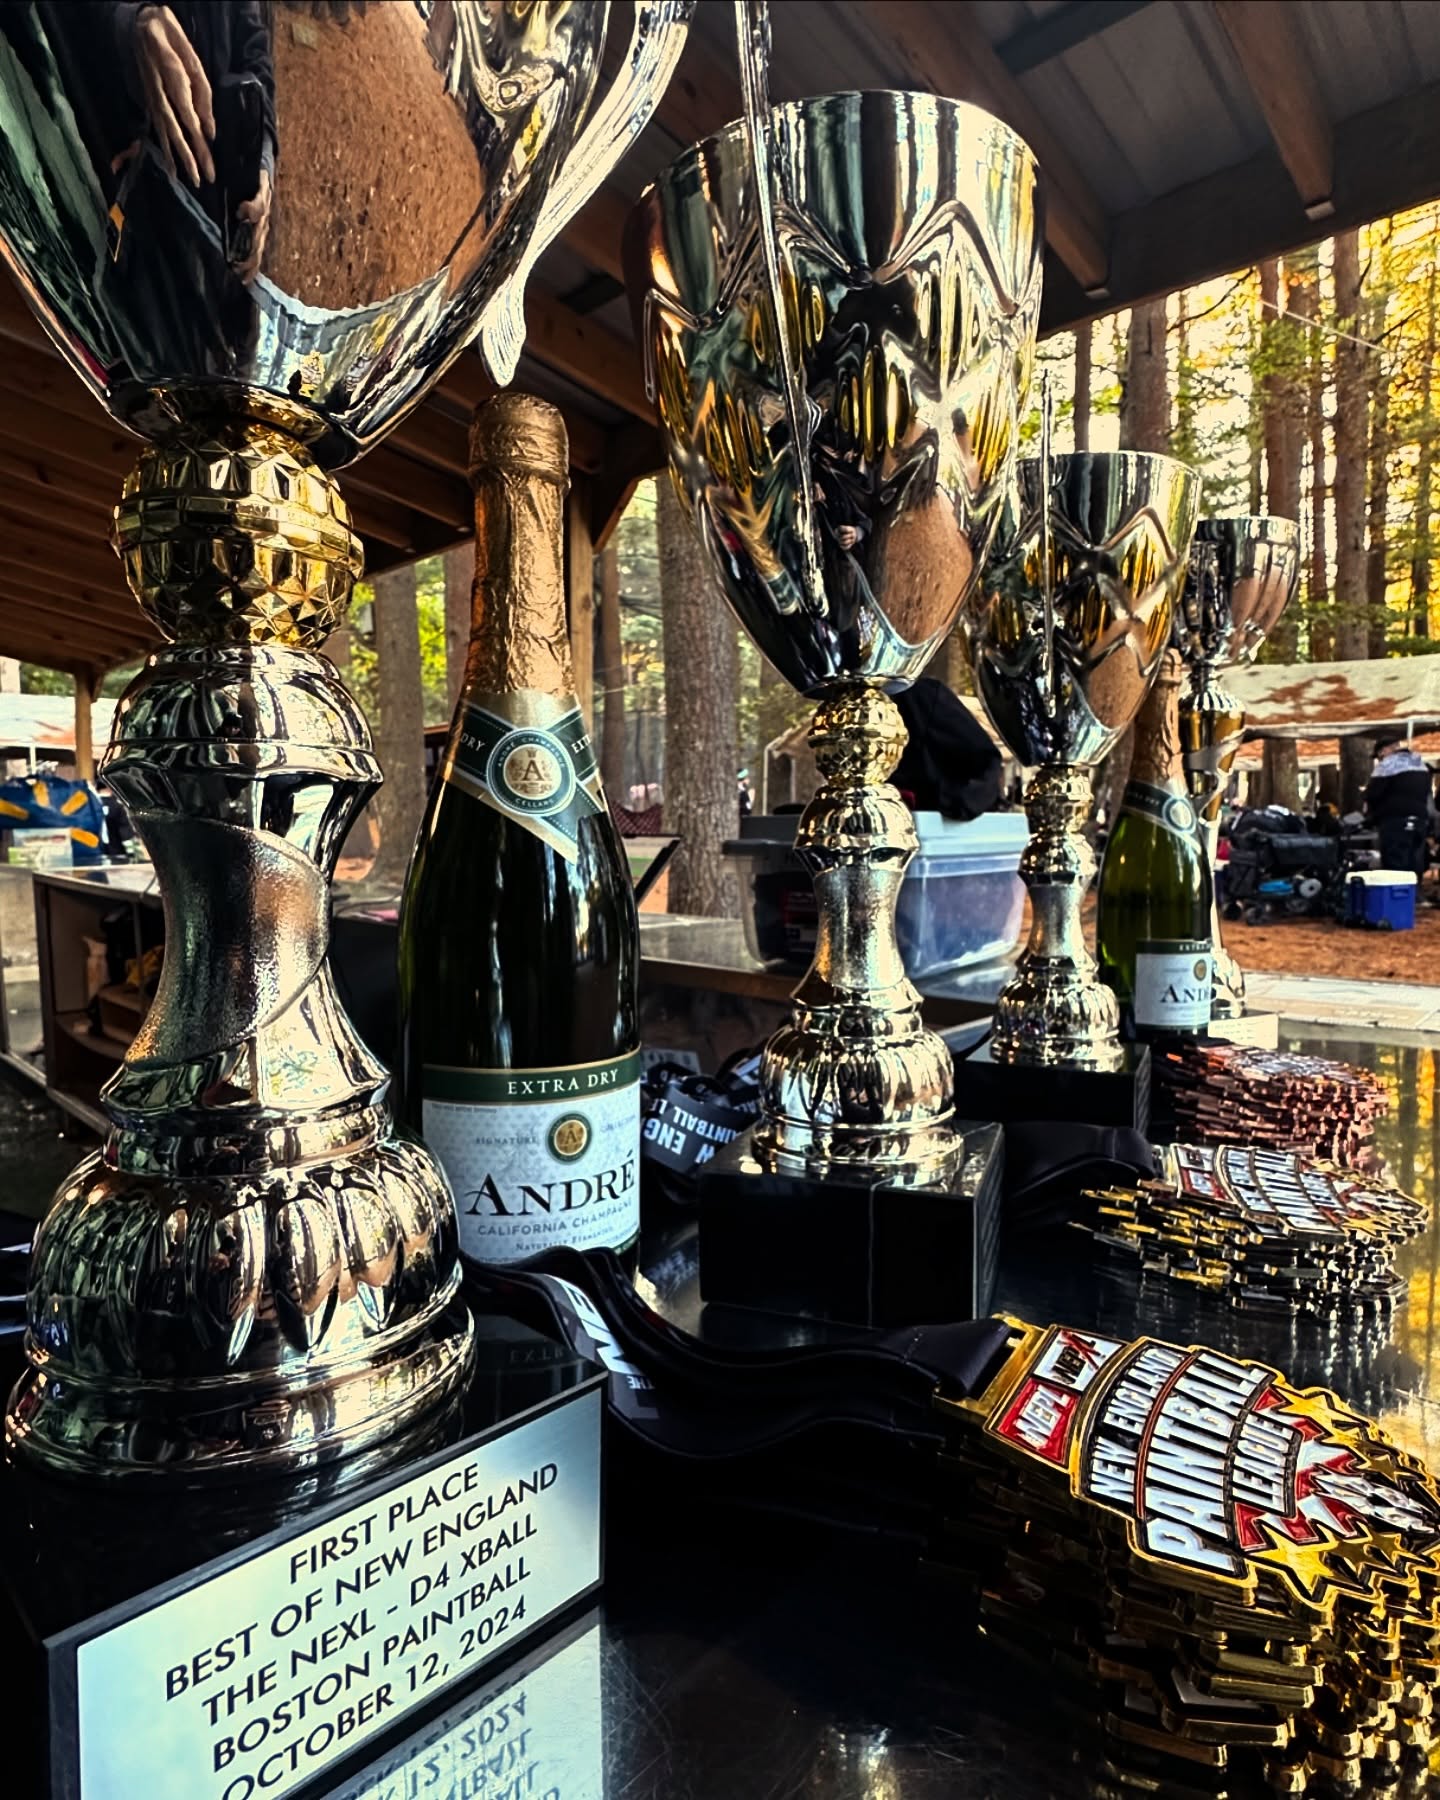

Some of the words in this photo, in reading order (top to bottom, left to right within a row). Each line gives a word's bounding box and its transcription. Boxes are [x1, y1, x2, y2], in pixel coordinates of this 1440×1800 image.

[522, 759, 545, 781] A
[507, 1076, 579, 1095] EXTRA
[587, 1068, 620, 1088] DRY
[464, 1149, 635, 1217] ANDRÉ
[478, 1219, 568, 1236] CALIFORNIA
[572, 1198, 633, 1228] CHAMPAGNE
[1103, 1348, 1186, 1437] ENGLAND
[1089, 1435, 1139, 1504] NEW
[1145, 1352, 1270, 1572] PAINTBALL
[1231, 1413, 1295, 1515] LEAGUE
[289, 1513, 377, 1584] FIRST
[388, 1462, 479, 1533] PLACE
[166, 1622, 259, 1701] BEST
[270, 1588, 324, 1639] OF
[335, 1538, 414, 1607] NEW
[422, 1462, 559, 1557] ENGLAND
[202, 1660, 278, 1727] THE
[290, 1607, 376, 1679] NEXL
[409, 1560, 452, 1607] D4
[459, 1513, 538, 1578] XBALL
[213, 1651, 371, 1773] BOSTON
[382, 1557, 532, 1667] PAINTBALL
[221, 1682, 395, 1800] OCTOBER
[406, 1652, 450, 1692] 12,
[459, 1595, 527, 1660] 2024
